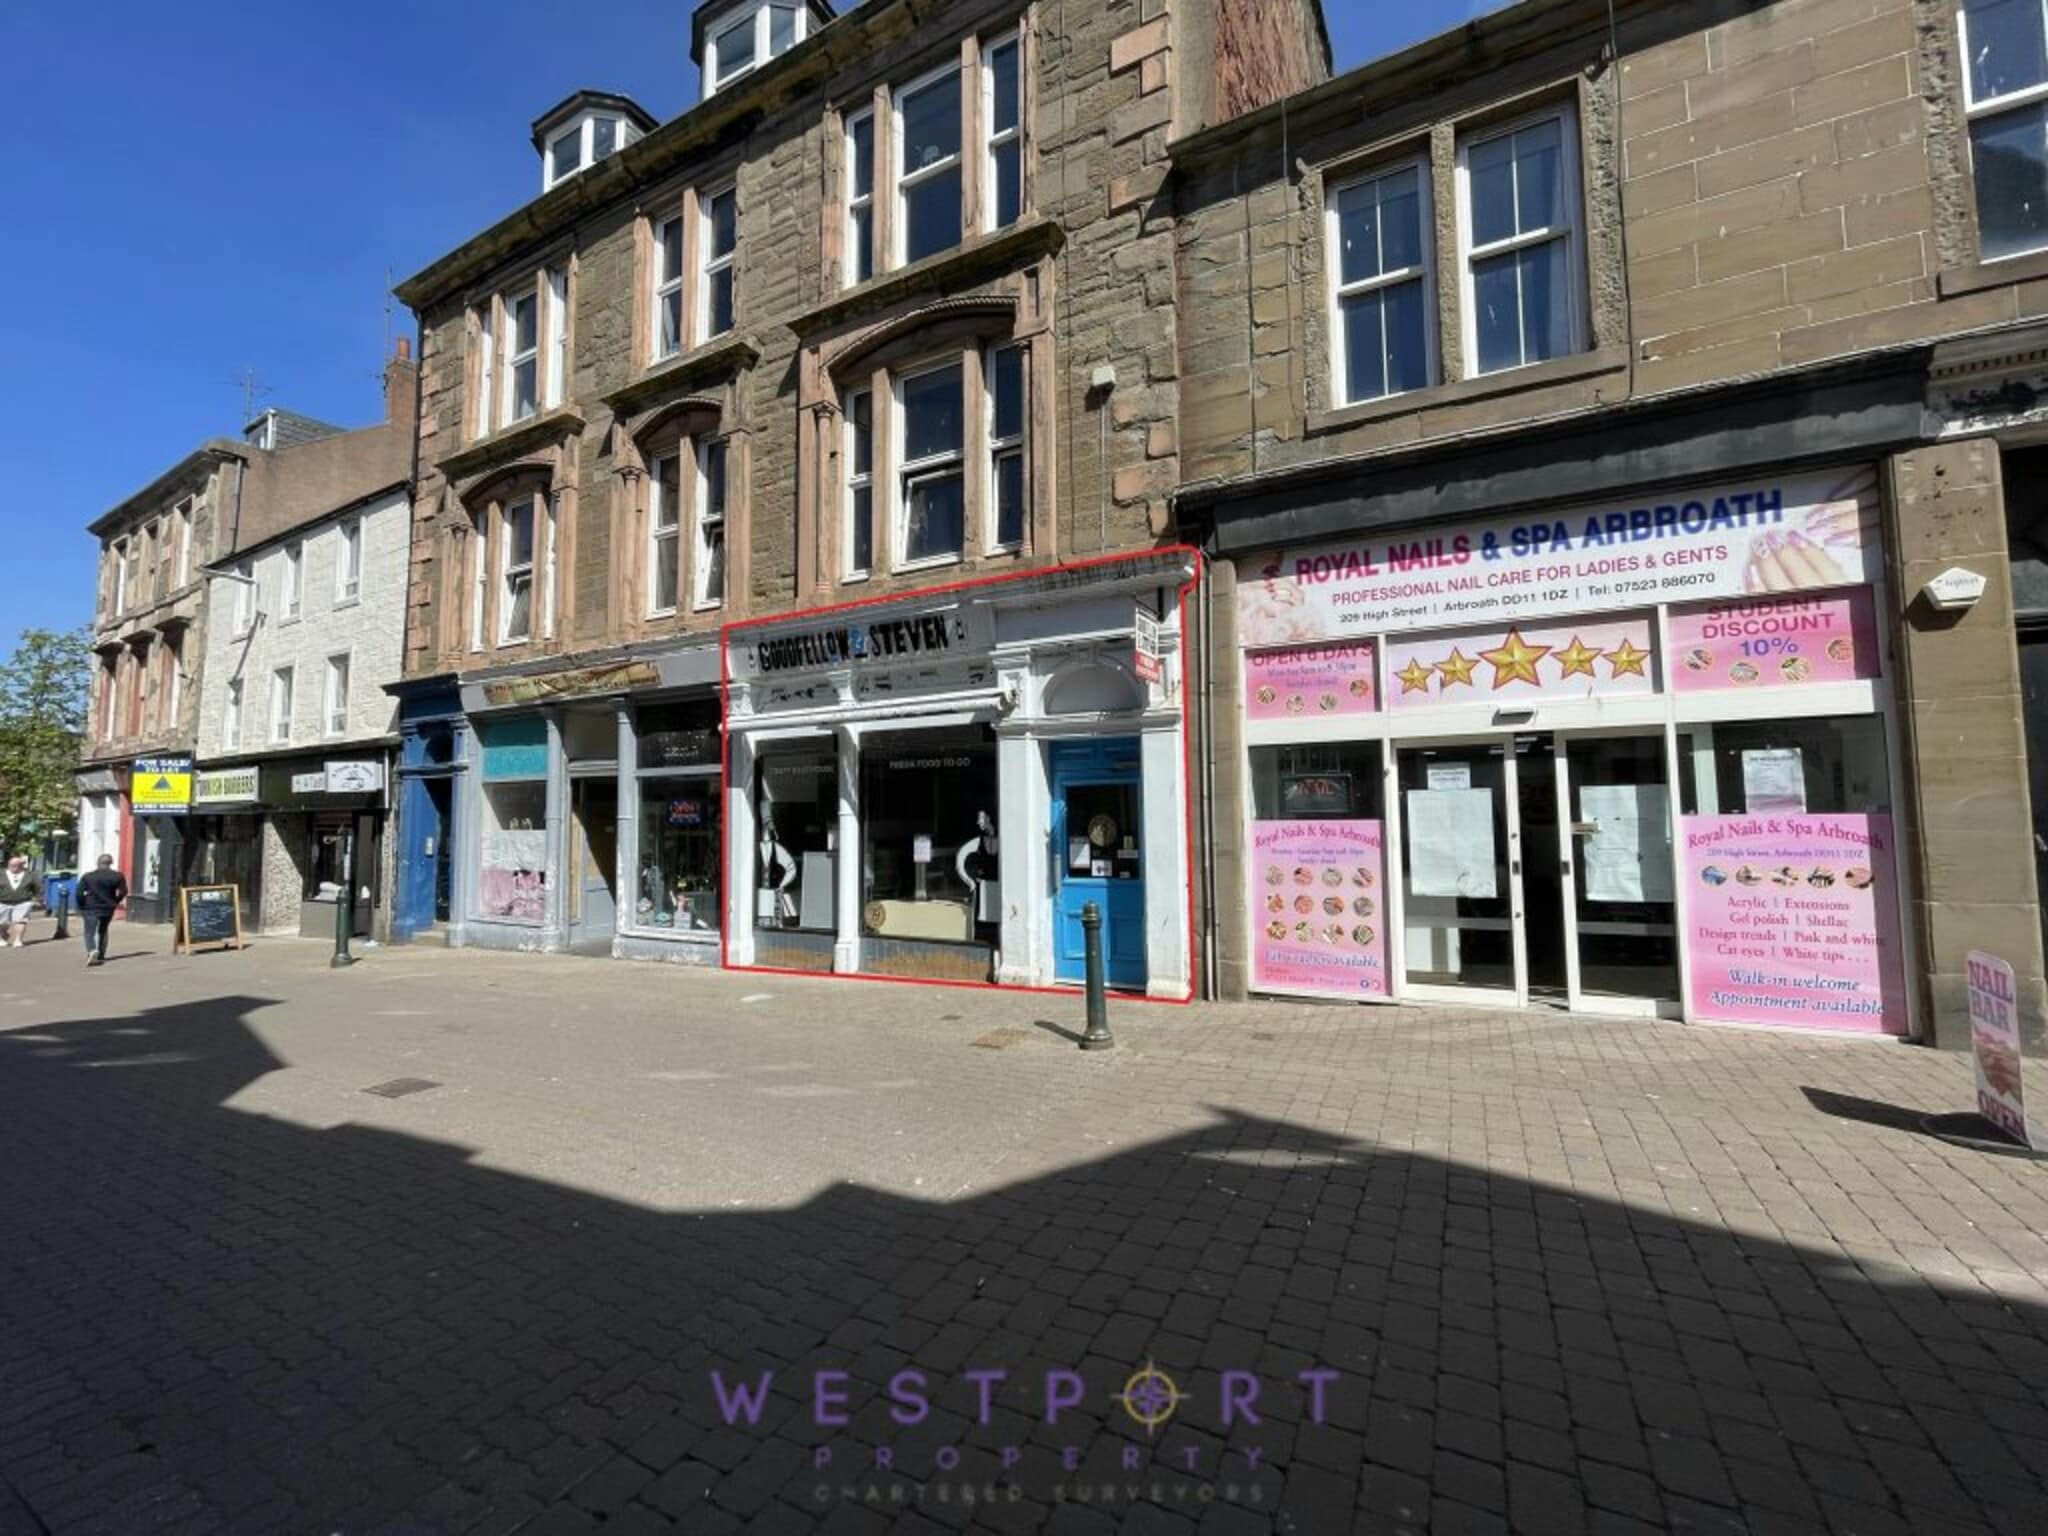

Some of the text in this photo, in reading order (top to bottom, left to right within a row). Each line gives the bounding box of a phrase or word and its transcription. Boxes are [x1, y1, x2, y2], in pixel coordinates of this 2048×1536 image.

[1296, 489, 1783, 585] ROYAL NAILS & SPA ARBROATH
[1332, 545, 1729, 606] PROFESSIONAL NAIL CARE FOR LADIES & GENTS
[1363, 609, 1389, 622] High
[1391, 605, 1427, 617] Street
[1443, 597, 1499, 612] Arbroath
[1502, 592, 1536, 606] DD11
[1542, 588, 1568, 601] 1DZ
[1615, 578, 1657, 593] 07523
[1708, 594, 1825, 622] STUDENT
[1703, 612, 1836, 640] DISCOUNT
[757, 628, 850, 673] GOODFELLOW
[869, 614, 949, 658] STEVEN
[1252, 648, 1301, 666] OPEN
[1323, 641, 1373, 660] DAYS
[1739, 636, 1799, 658] 10%
[1688, 819, 1885, 850] Royal Nails & Spa Arbroath
[1727, 896, 1850, 911] Acrylic Extensions
[1729, 911, 1849, 928] Gel polish Shellac
[1699, 927, 1736, 941] Design
[1741, 929, 1777, 941] trends
[1794, 931, 1821, 944] Pink
[1826, 932, 1848, 945] and
[1717, 943, 1737, 956] Cat
[1741, 946, 1765, 959] eyes
[1782, 946, 1818, 959] White
[1728, 968, 1860, 992] Walk-in welcome
[1968, 959, 2014, 1003] NAIL
[1711, 990, 1886, 1015] Appointment available
[1970, 988, 2011, 1033] BAR
[1977, 1088, 2029, 1141] OPEN
